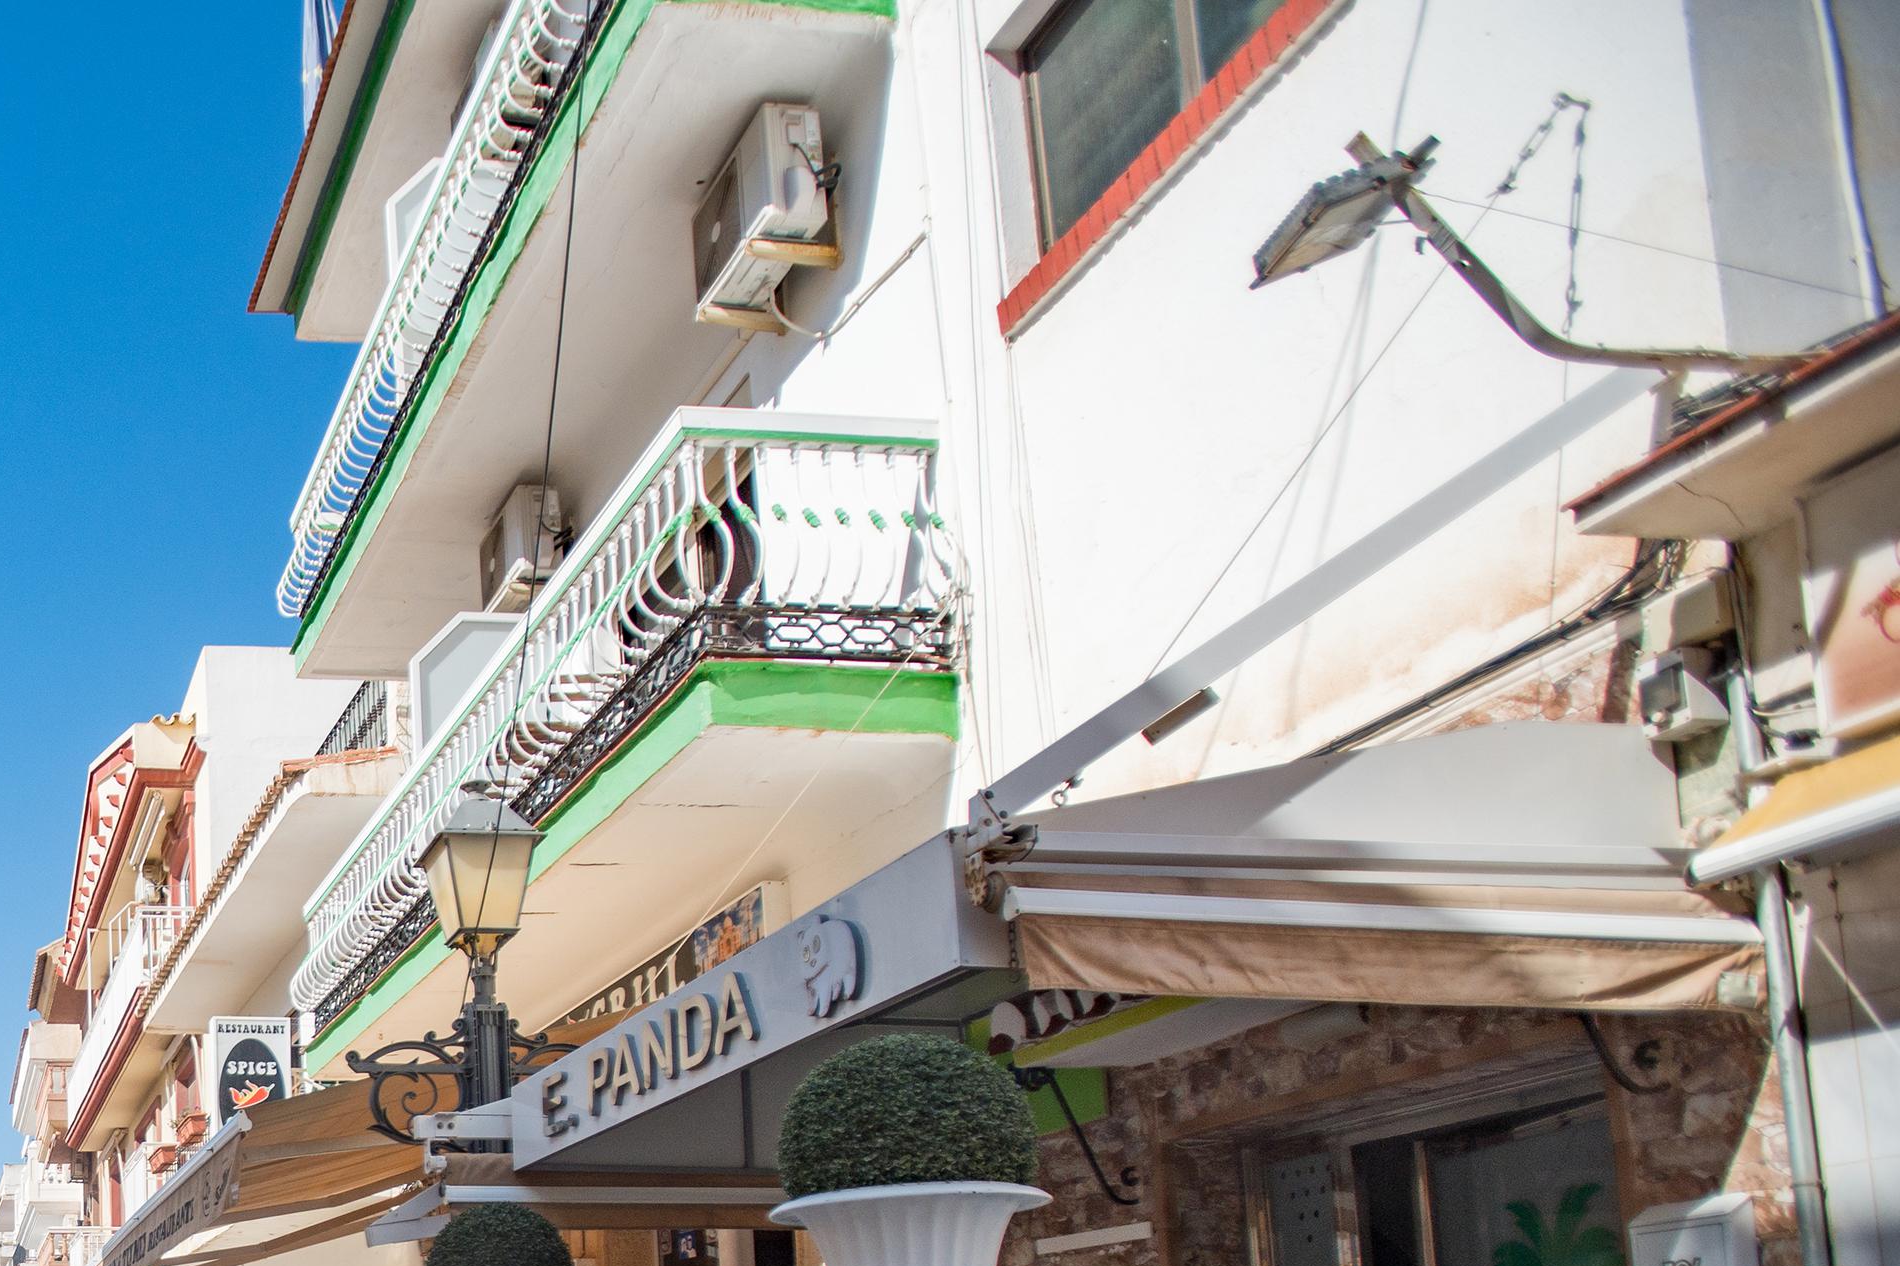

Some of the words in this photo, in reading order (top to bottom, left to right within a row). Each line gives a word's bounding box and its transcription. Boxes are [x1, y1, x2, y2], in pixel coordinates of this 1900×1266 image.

[217, 1023, 286, 1034] RESTAURANT
[587, 971, 761, 1117] PANDA
[226, 1060, 278, 1076] SPICE
